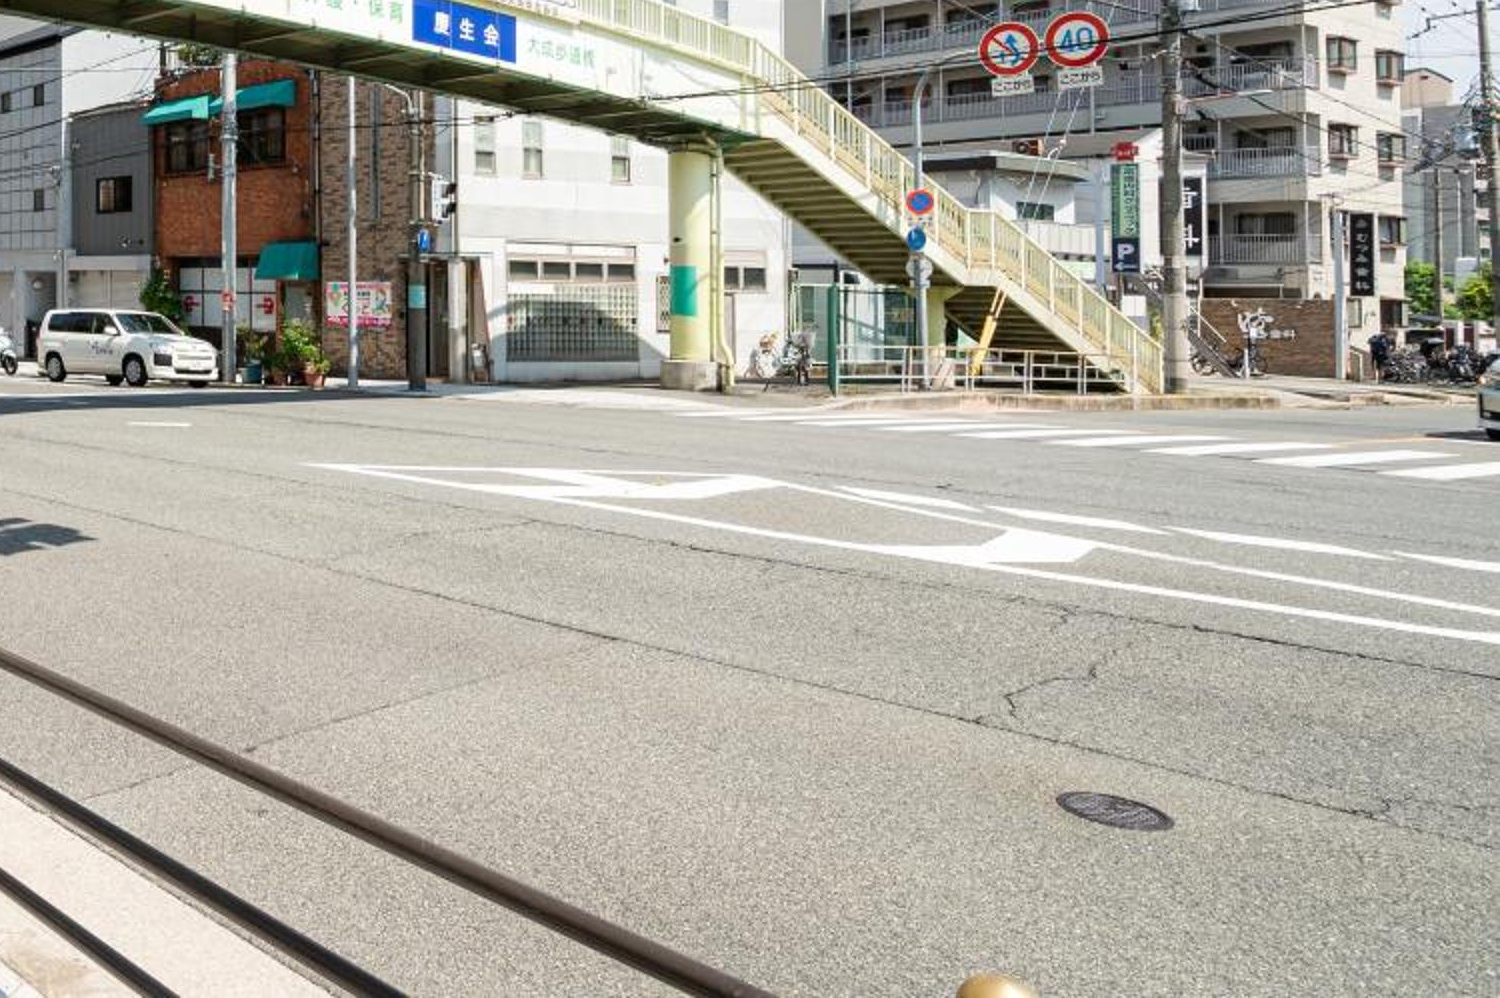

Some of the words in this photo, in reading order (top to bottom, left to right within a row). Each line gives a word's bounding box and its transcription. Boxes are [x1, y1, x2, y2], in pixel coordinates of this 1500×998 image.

[1061, 27, 1093, 52] 40
[1059, 72, 1101, 85] ここから
[994, 80, 1032, 93] ここから
[1117, 243, 1135, 260] P
